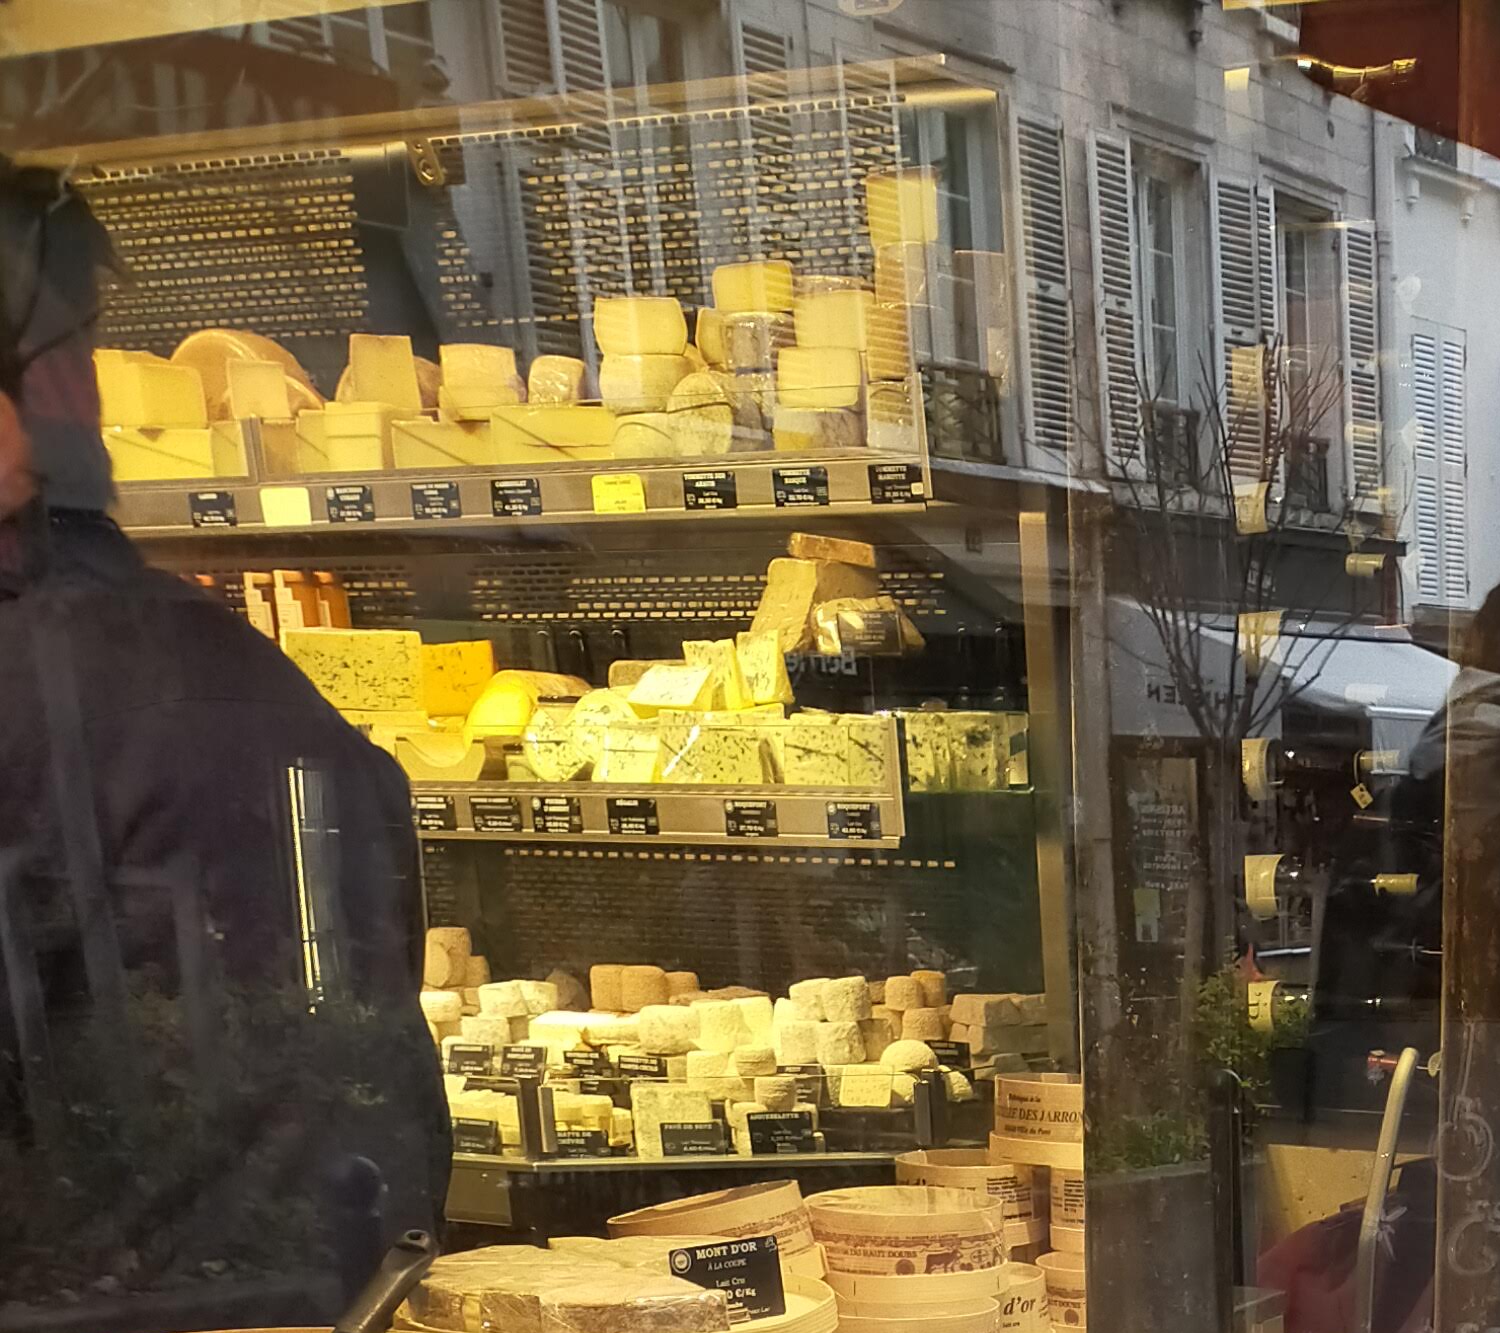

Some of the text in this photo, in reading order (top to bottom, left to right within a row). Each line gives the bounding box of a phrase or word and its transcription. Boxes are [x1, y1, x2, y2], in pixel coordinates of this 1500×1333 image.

[1018, 1107, 1039, 1121] DES
[696, 1240, 758, 1261] MONT D'OR
[715, 1275, 746, 1288] Lait Cru
